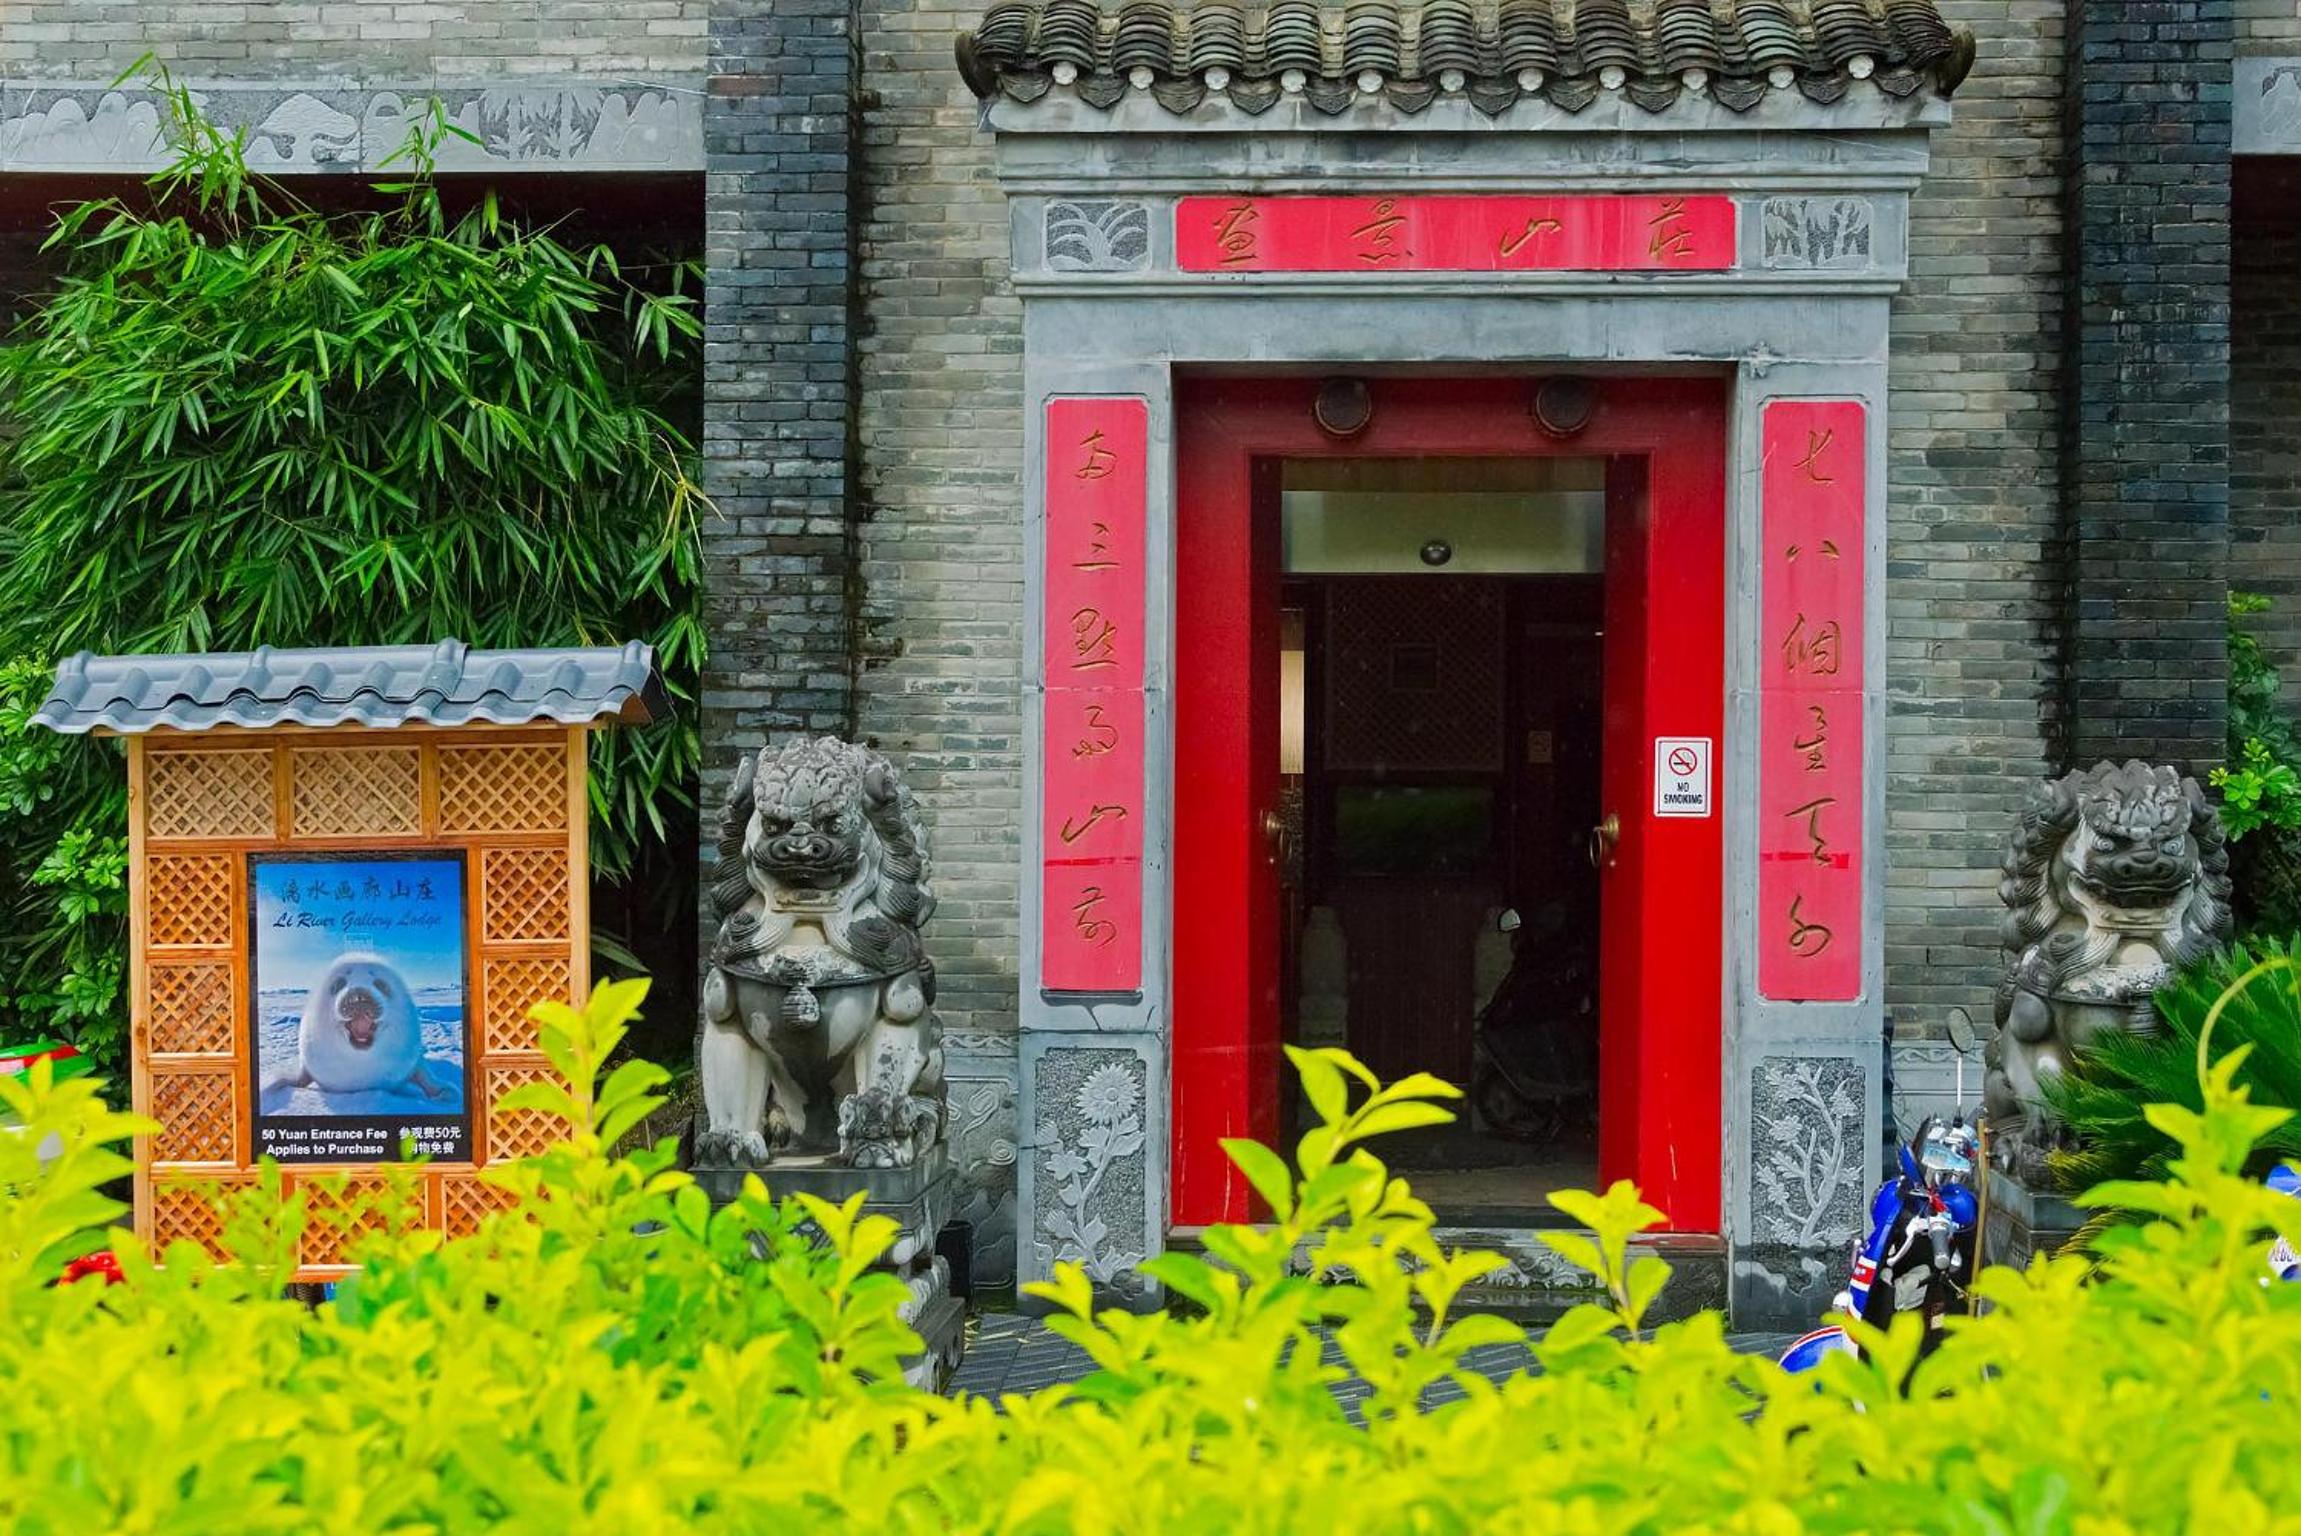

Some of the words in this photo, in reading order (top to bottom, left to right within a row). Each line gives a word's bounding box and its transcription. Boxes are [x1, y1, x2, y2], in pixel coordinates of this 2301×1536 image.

[1677, 782, 1690, 793] NO
[1663, 794, 1703, 804] SMOKING
[273, 912, 293, 928] Li
[297, 911, 335, 928] River
[343, 910, 392, 932] Gallery
[396, 911, 442, 931] Lodge
[262, 1129, 276, 1140] 50
[278, 1129, 308, 1140] Yuan
[311, 1129, 363, 1140] Entrance
[366, 1128, 388, 1139] Fee
[266, 1144, 311, 1157] Applies
[313, 1144, 326, 1154] to
[328, 1143, 384, 1154] Purchase
